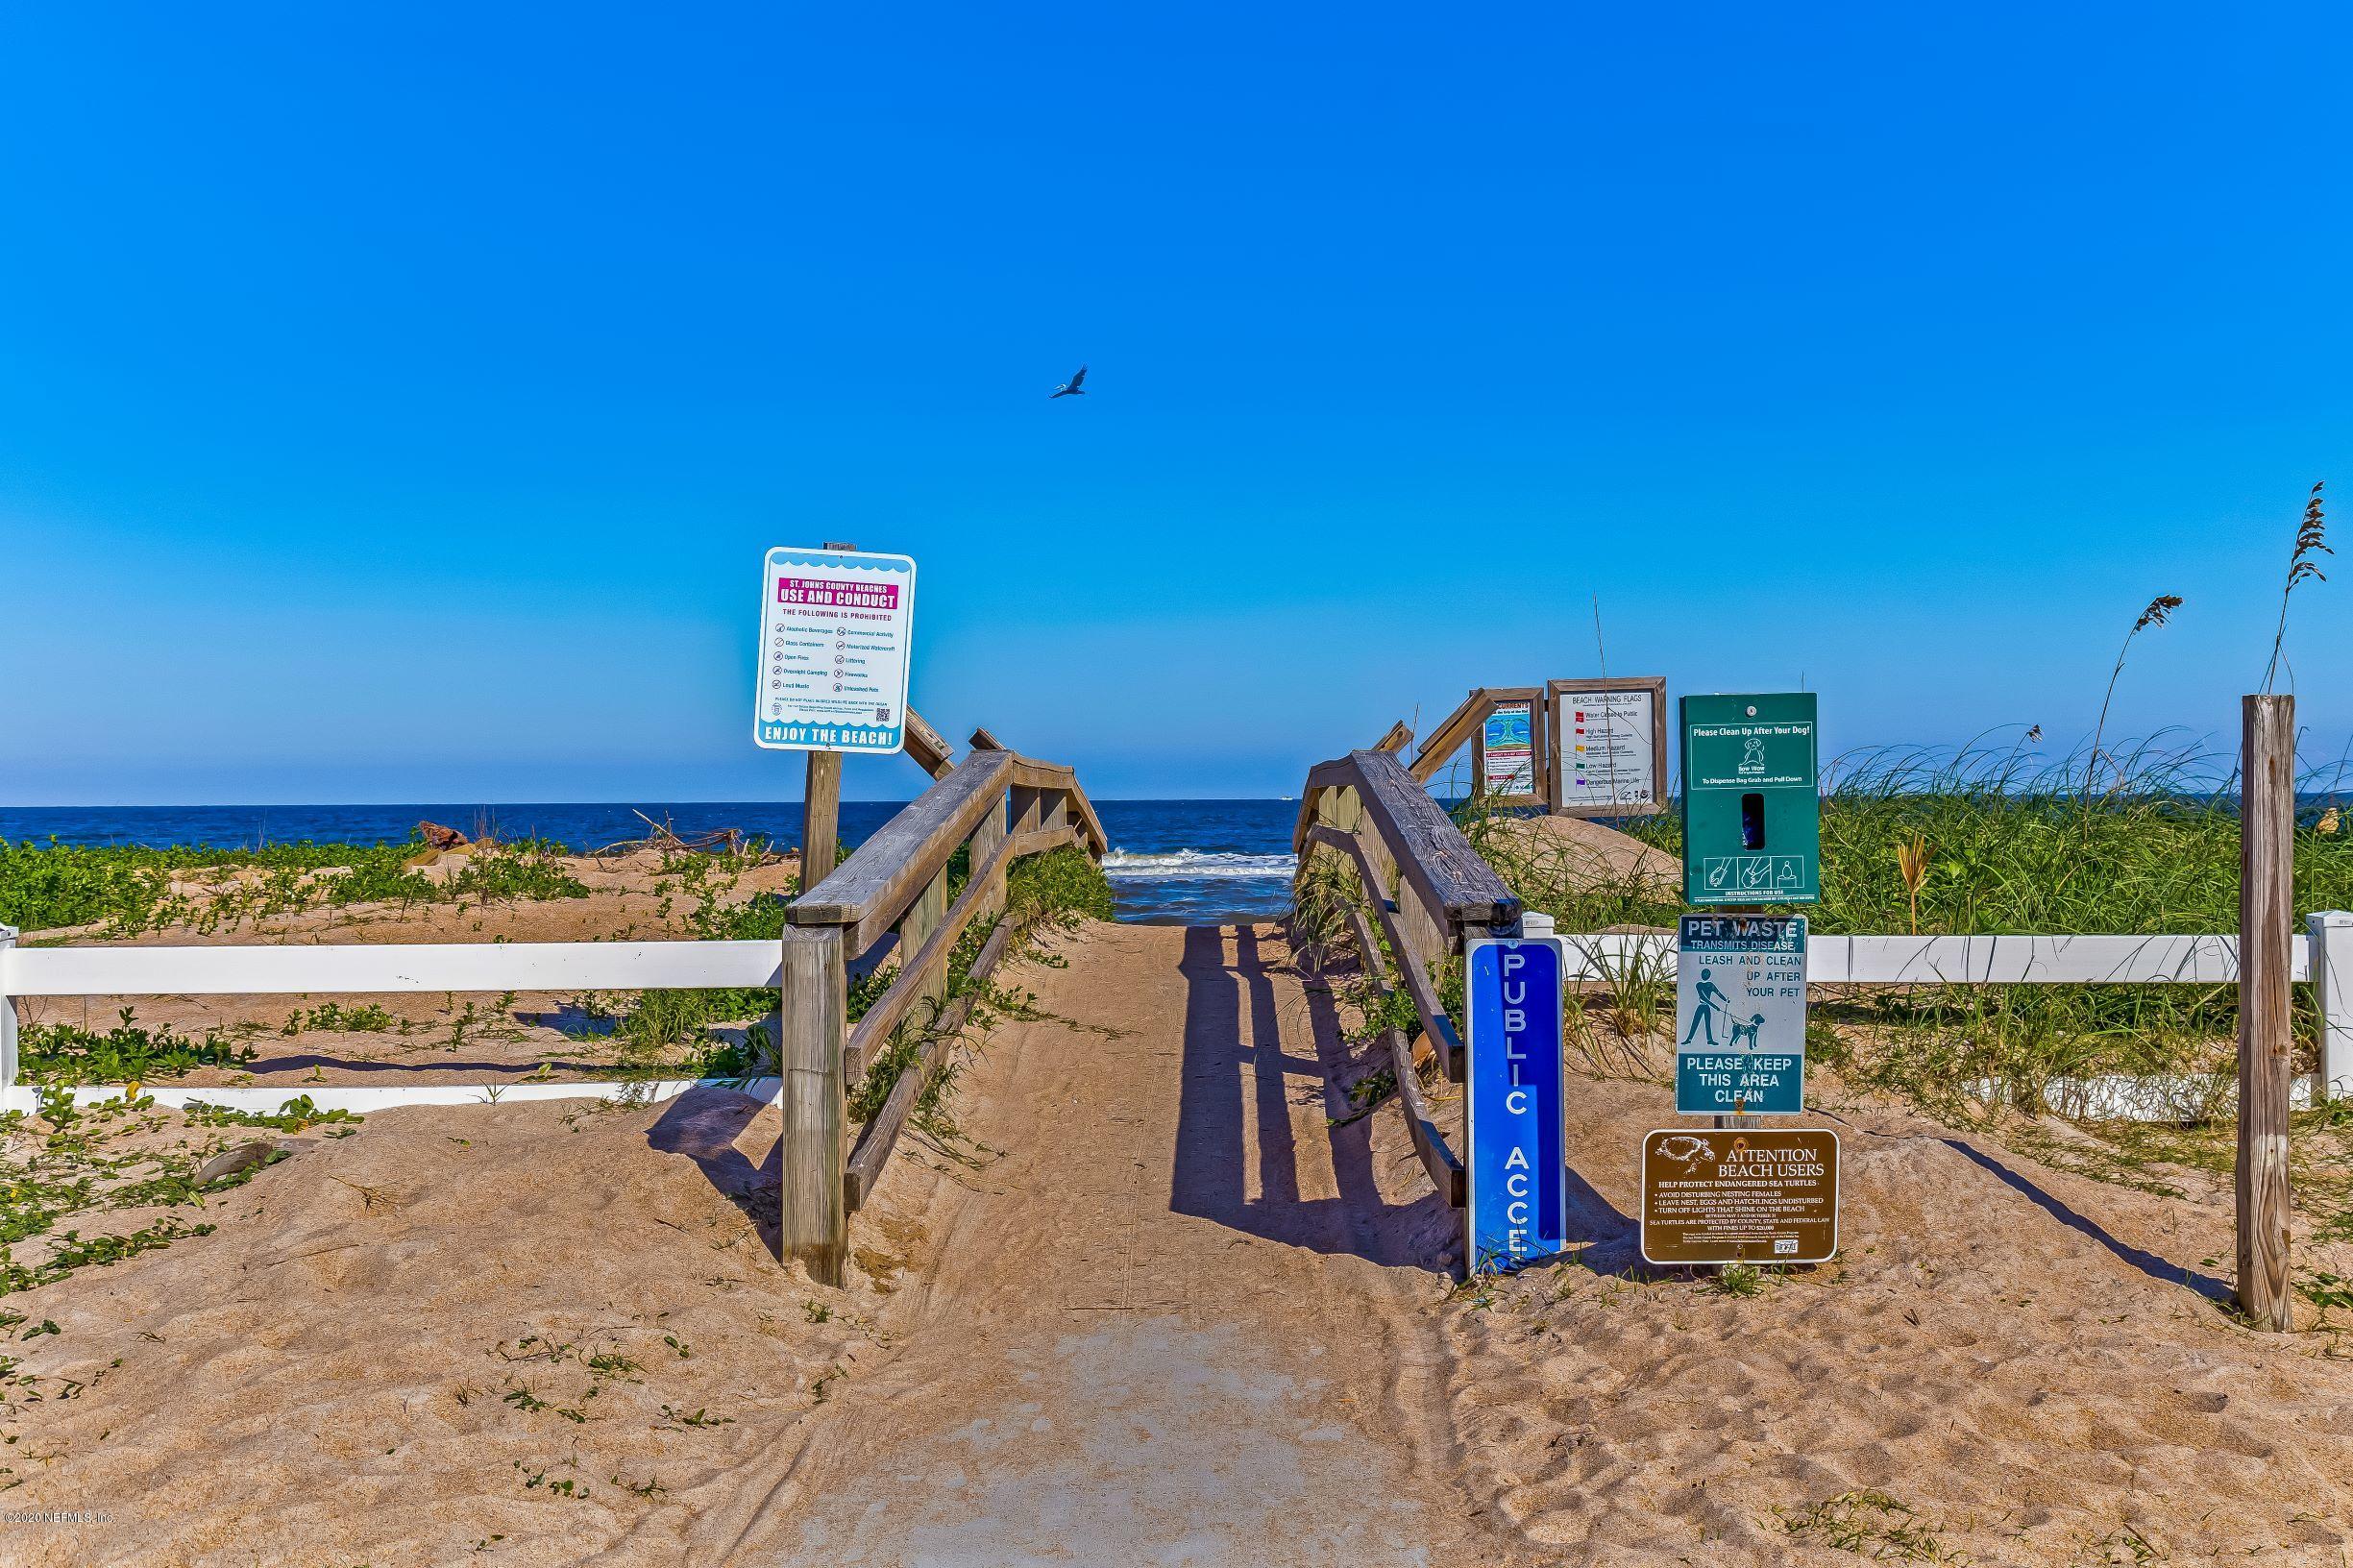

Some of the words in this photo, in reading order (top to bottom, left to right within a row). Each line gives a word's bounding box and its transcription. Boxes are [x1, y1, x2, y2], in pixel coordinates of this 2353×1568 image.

[790, 579, 800, 588] ST.
[801, 580, 824, 589] JOHNS
[826, 581, 853, 591] COUNTY
[856, 583, 888, 593] BEACHES
[780, 588, 804, 602] USE
[807, 589, 833, 604] AND
[836, 592, 895, 608] CONDUCT
[798, 609, 839, 618] FOLLOWING
[850, 612, 892, 622] PROHIBITED
[1572, 696, 1592, 704] BEACH
[1595, 695, 1622, 703] WARNING
[1624, 694, 1642, 702] FLAGS
[765, 726, 807, 741] ENJOY
[811, 728, 837, 743] THE
[841, 729, 893, 746] BEACH!
[1693, 728, 1718, 737] Please
[1741, 727, 1752, 737] Up
[1753, 726, 1773, 735] After
[1792, 725, 1810, 735] Dog!
[1688, 920, 1724, 937] PET
[1733, 920, 1798, 938] WASTE
[1691, 940, 1747, 950] TRANSMITS
[1751, 941, 1795, 951] DISEASE
[1699, 955, 1733, 965] LEASH
[1738, 955, 1761, 966] AND
[1766, 955, 1802, 966] CLEAN
[1747, 971, 1761, 981] UP
[1766, 971, 1801, 982] AFTER
[1746, 987, 1775, 997] YOUR
[1780, 987, 1801, 997] PET
[1504, 954, 1527, 1115] PUBLIC
[1686, 1057, 1743, 1070] PLEASE
[1753, 1058, 1792, 1071] KEEP
[1699, 1073, 1731, 1087] THIS
[1739, 1073, 1779, 1087] AREA
[1714, 1090, 1764, 1103] CLEAN
[1726, 1148, 1818, 1163] ATTENTION
[1718, 1164, 1774, 1178] BEACH
[1777, 1164, 1825, 1177] USERS
[1504, 1146, 1530, 1267] ACCE
